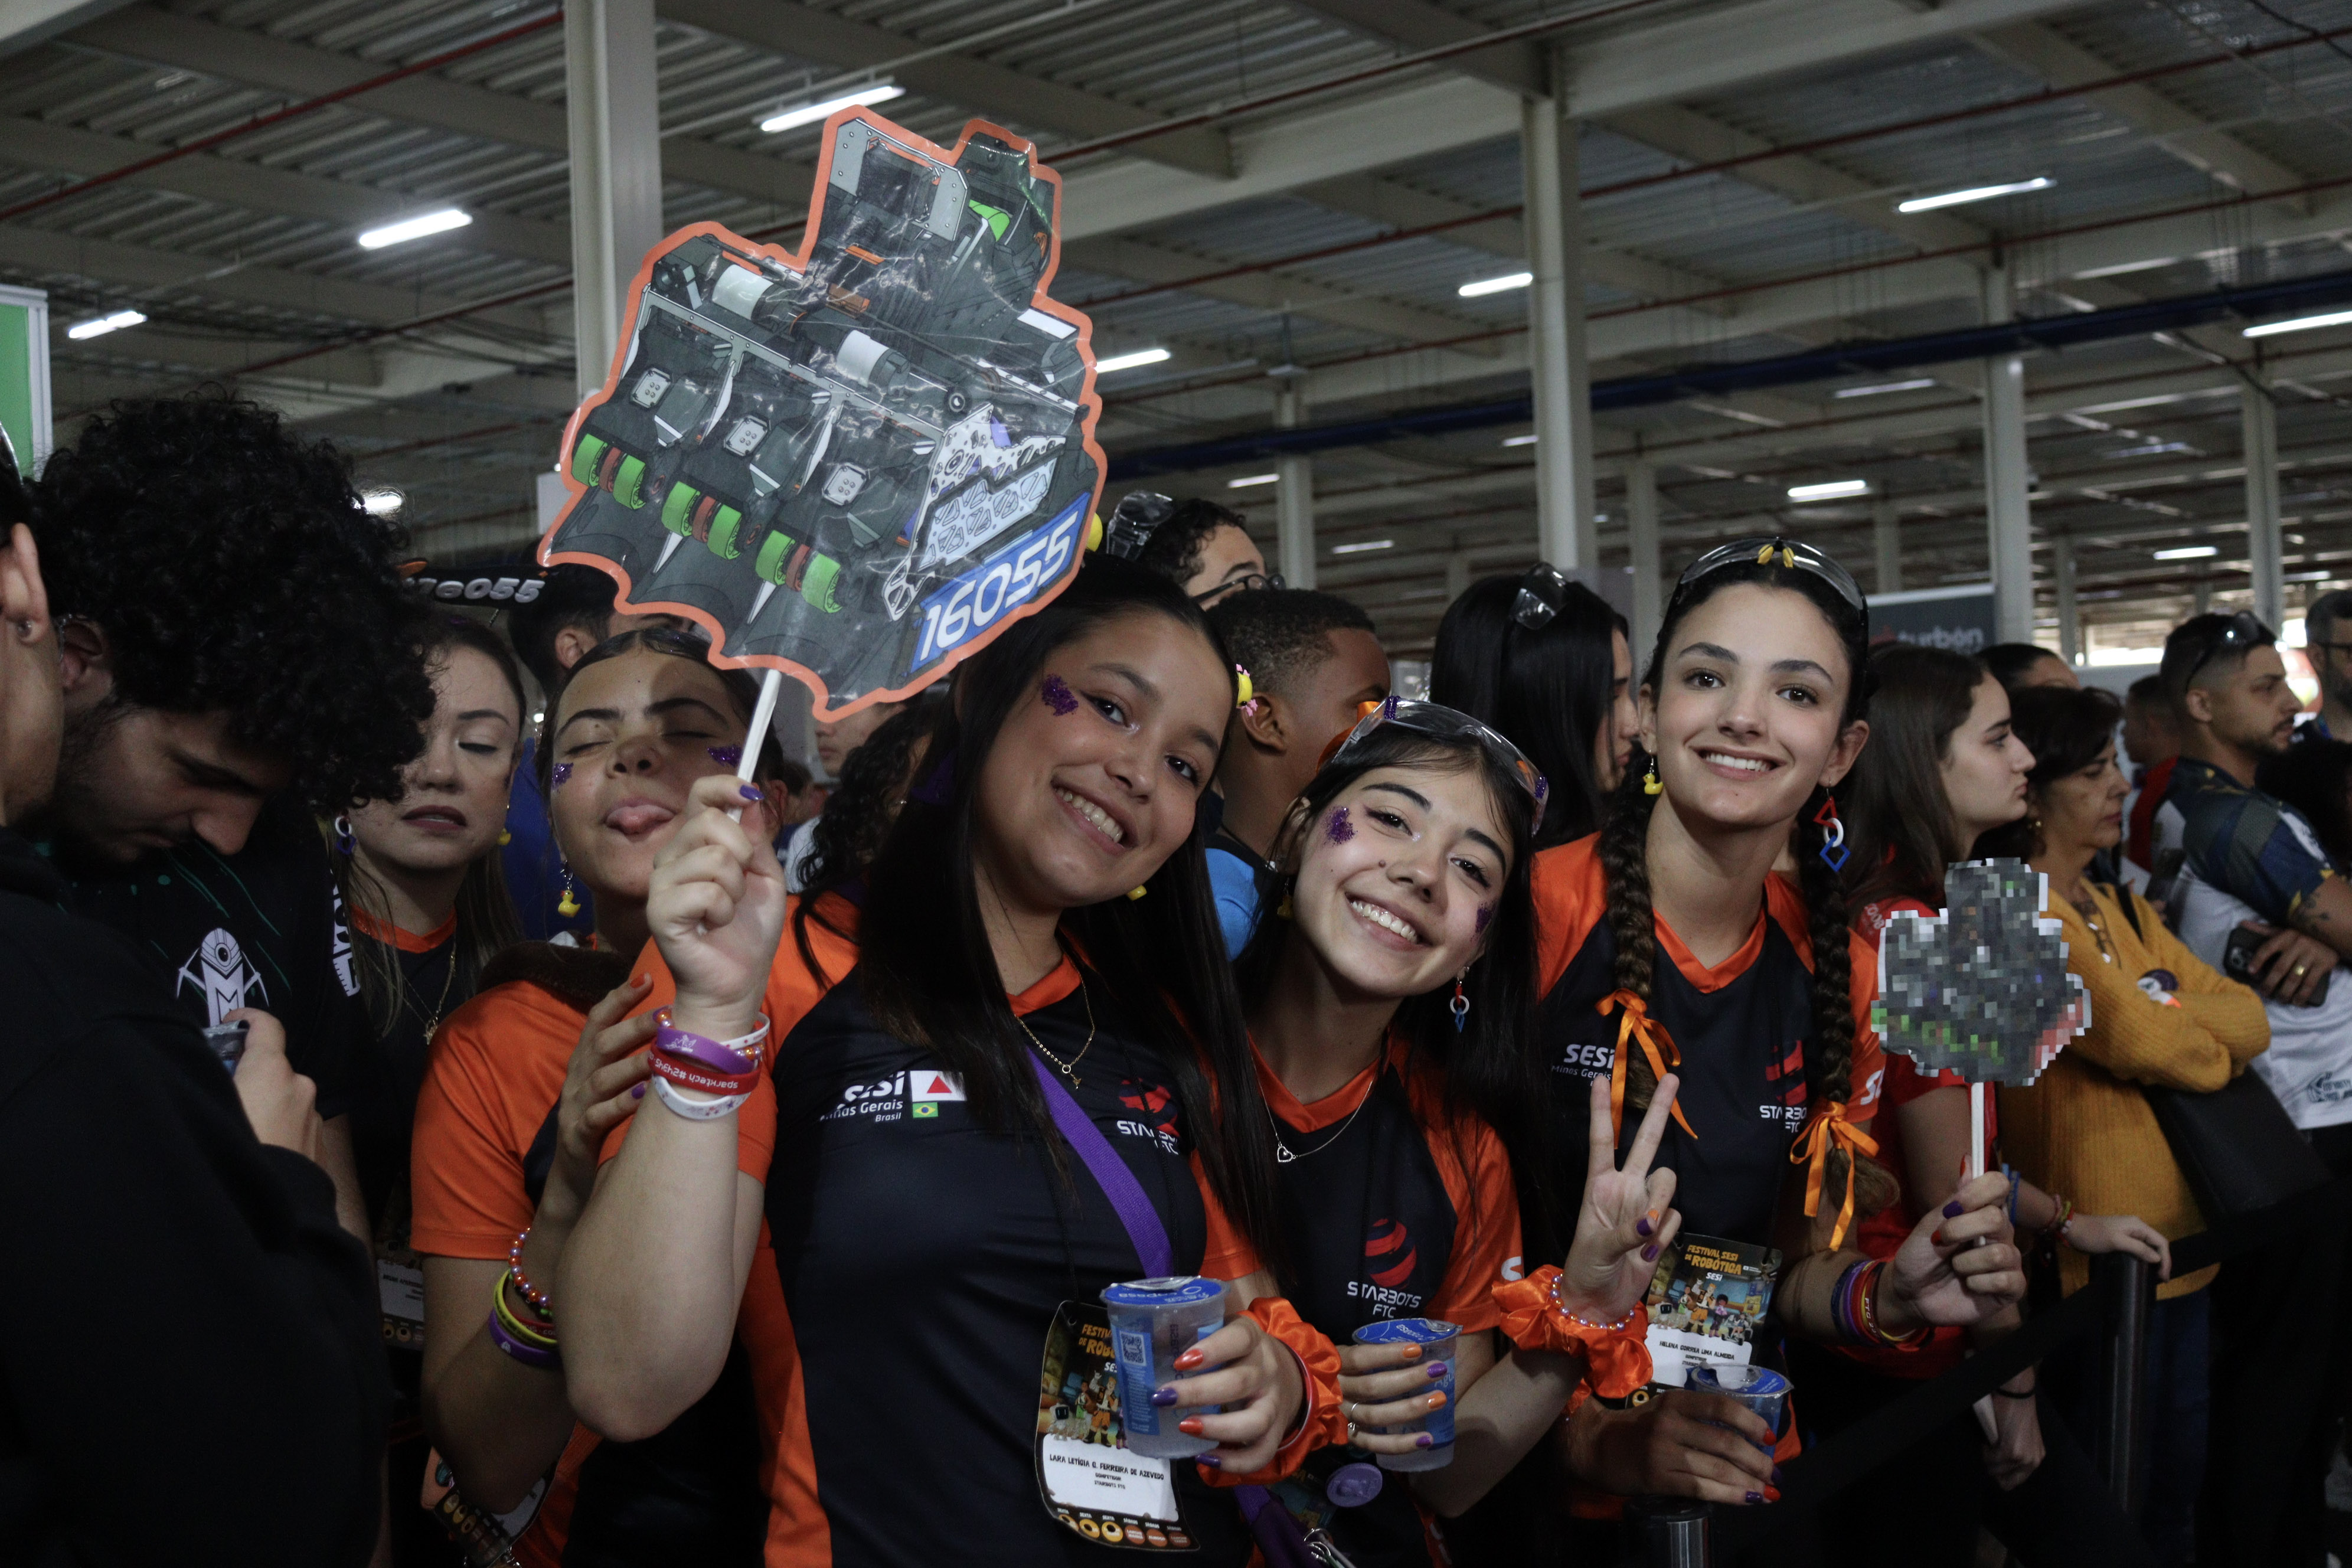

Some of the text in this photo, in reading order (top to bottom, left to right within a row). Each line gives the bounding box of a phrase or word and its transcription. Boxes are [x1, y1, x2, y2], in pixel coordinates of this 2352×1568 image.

[920, 511, 1079, 661] 16055
[1551, 1065, 1577, 1076] Minas
[860, 1099, 903, 1113] Gerais
[875, 1112, 901, 1122] Brasil
[1687, 1244, 1739, 1262] FESTIVAL SESI
[1691, 1255, 1742, 1275] ROBÓTICA
[1347, 1281, 1422, 1308] STARBOTS
[1373, 1304, 1396, 1318] FTC
[1660, 1341, 1678, 1350] HELENA
[1050, 1454, 1066, 1464] LARA
[1068, 1456, 1090, 1466] LETÍCIA
[1100, 1463, 1128, 1473] FERREIRA
[1139, 1470, 1165, 1480] AZEVEDO
